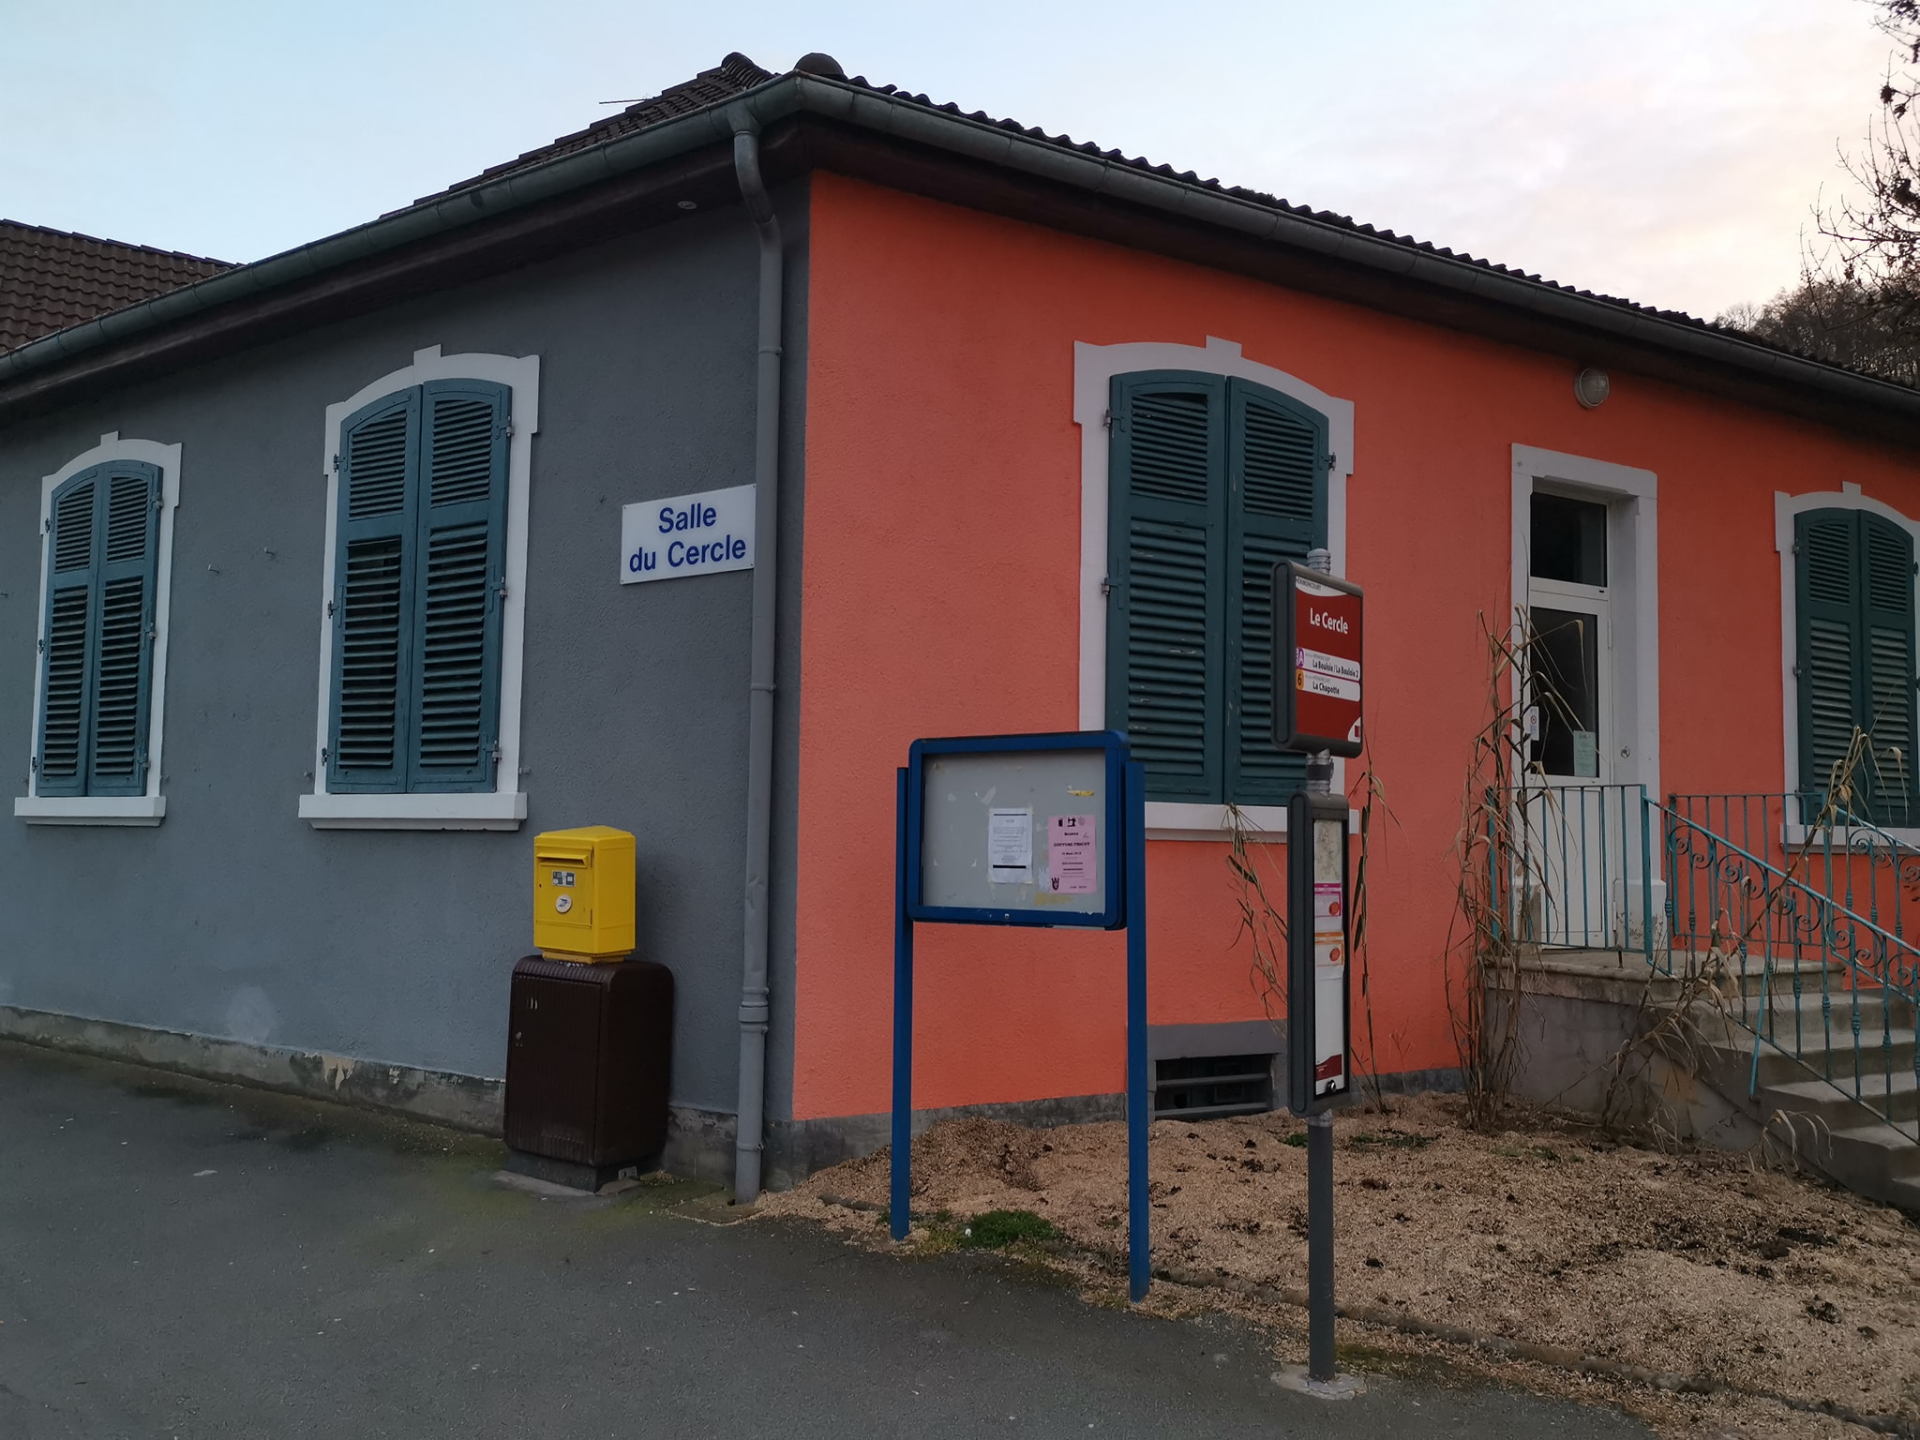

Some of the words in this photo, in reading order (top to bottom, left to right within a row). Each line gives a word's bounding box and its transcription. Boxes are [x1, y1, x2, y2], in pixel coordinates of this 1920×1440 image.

[658, 502, 717, 533] Salle
[629, 546, 656, 573] du
[667, 534, 746, 567] Cercle
[1310, 607, 1321, 627] Le
[1322, 612, 1348, 634] Cercle
[1298, 674, 1303, 686] 6
[1313, 681, 1319, 690] La
